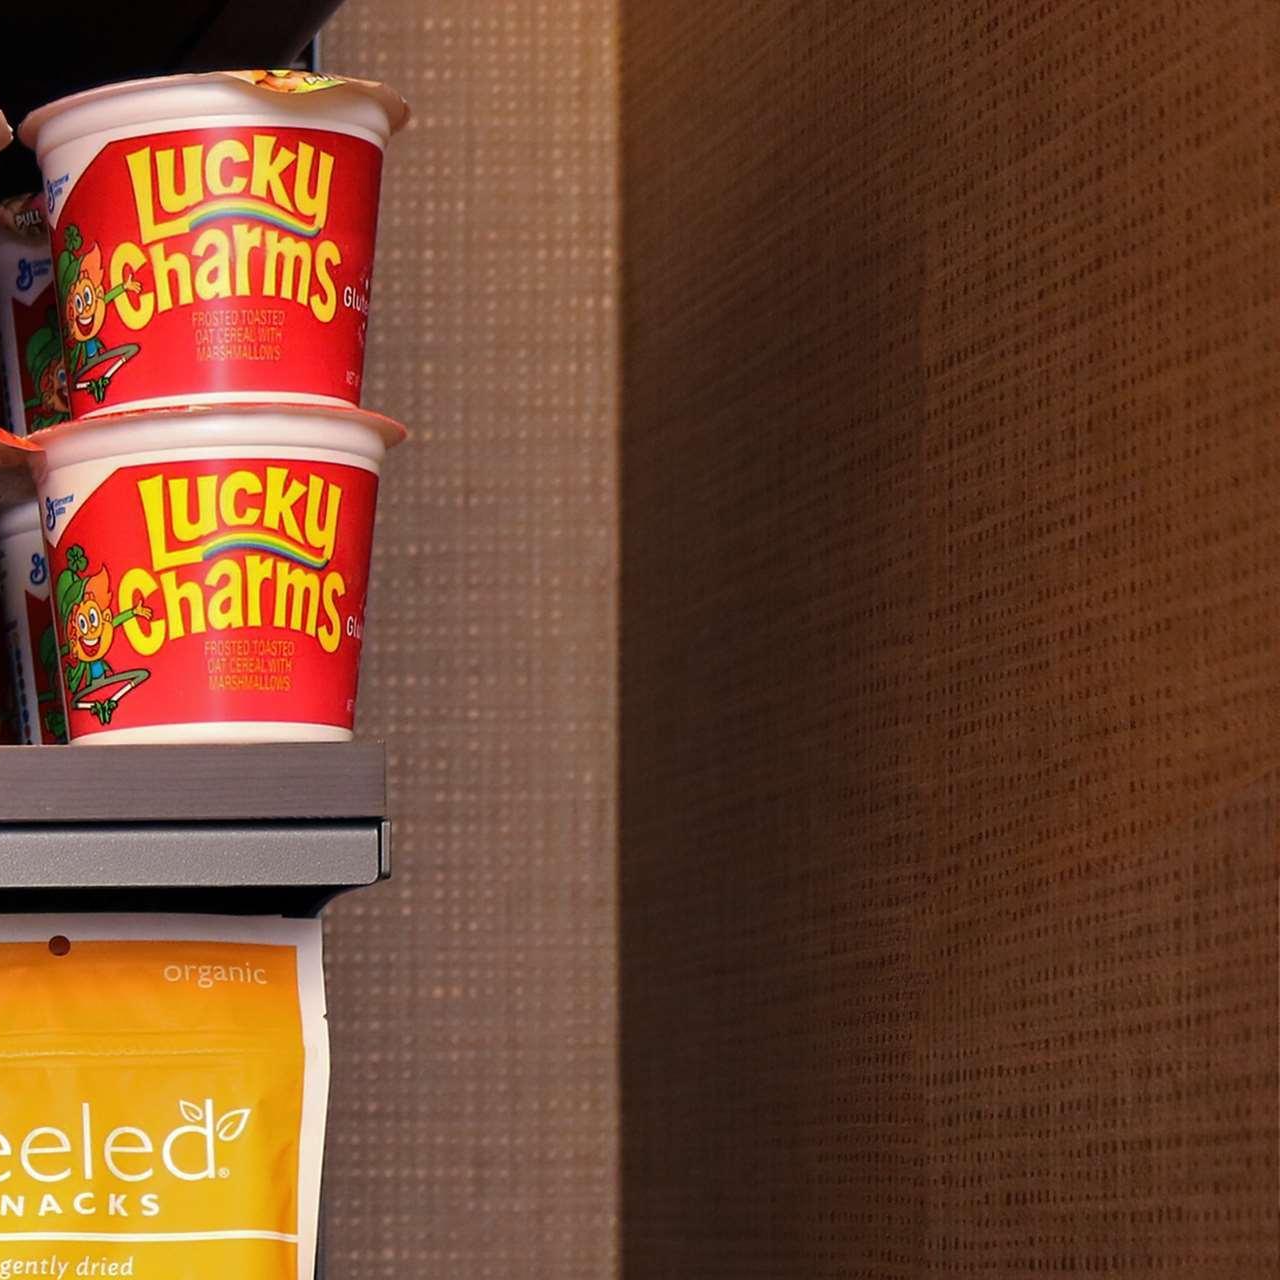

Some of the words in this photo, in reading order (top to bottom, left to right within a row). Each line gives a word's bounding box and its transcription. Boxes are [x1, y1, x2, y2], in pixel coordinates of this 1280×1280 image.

[126, 134, 334, 244] Lucky
[109, 223, 342, 330] Charms
[192, 311, 241, 326] FROSTED
[137, 466, 342, 572] Lucky
[118, 554, 345, 656] Charms
[163, 962, 267, 988] organic
[0, 1256, 69, 1280] gently
[76, 1255, 133, 1277] dried
